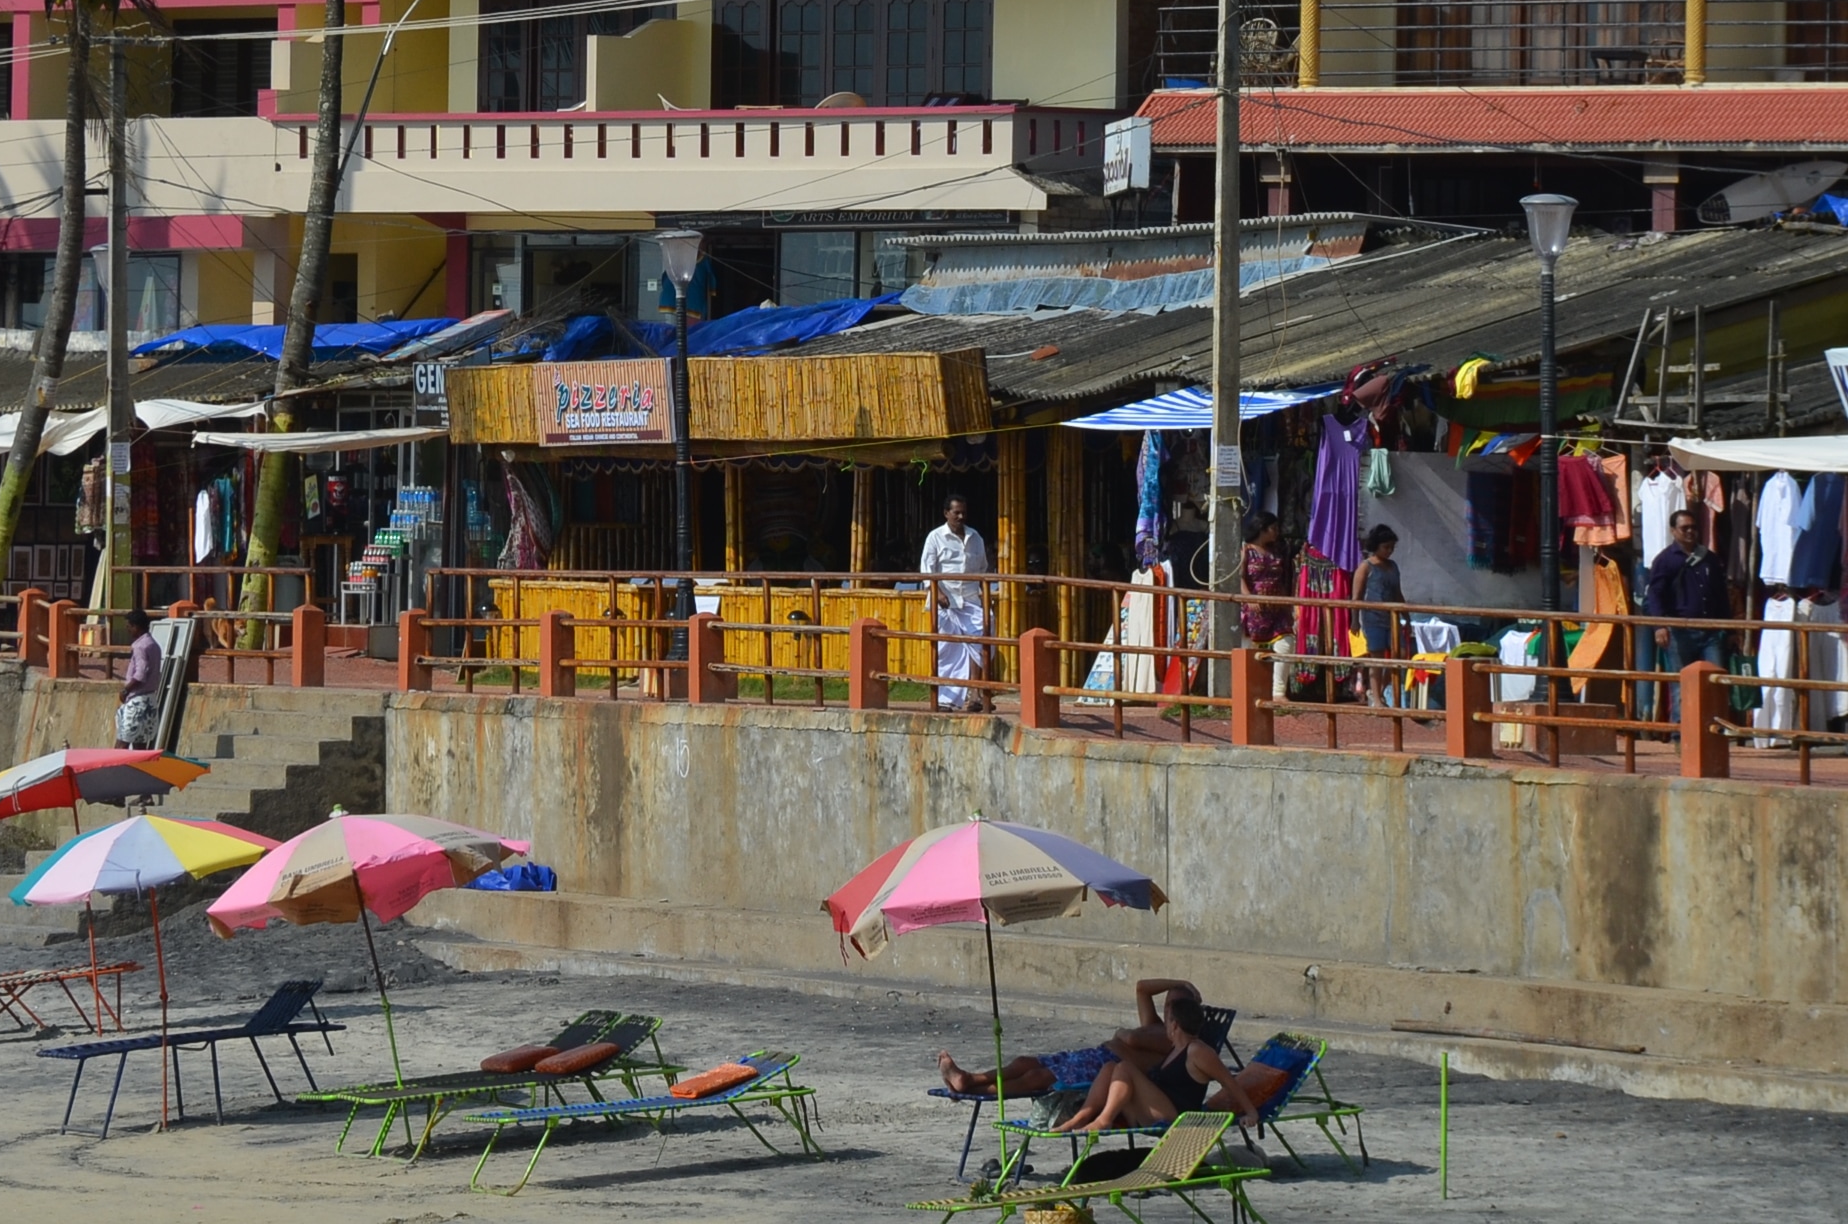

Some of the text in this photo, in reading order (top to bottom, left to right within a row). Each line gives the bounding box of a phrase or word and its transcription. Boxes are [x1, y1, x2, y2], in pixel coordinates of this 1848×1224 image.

[799, 211, 914, 222] ARTS EMPORIUM
[416, 364, 446, 394] GEN
[556, 380, 653, 424] pizzeria
[566, 410, 649, 429] SEA FOOD RESTAURANT
[304, 856, 345, 874] UMBRELLA
[985, 865, 1060, 880] BAVA UMBRELLA
